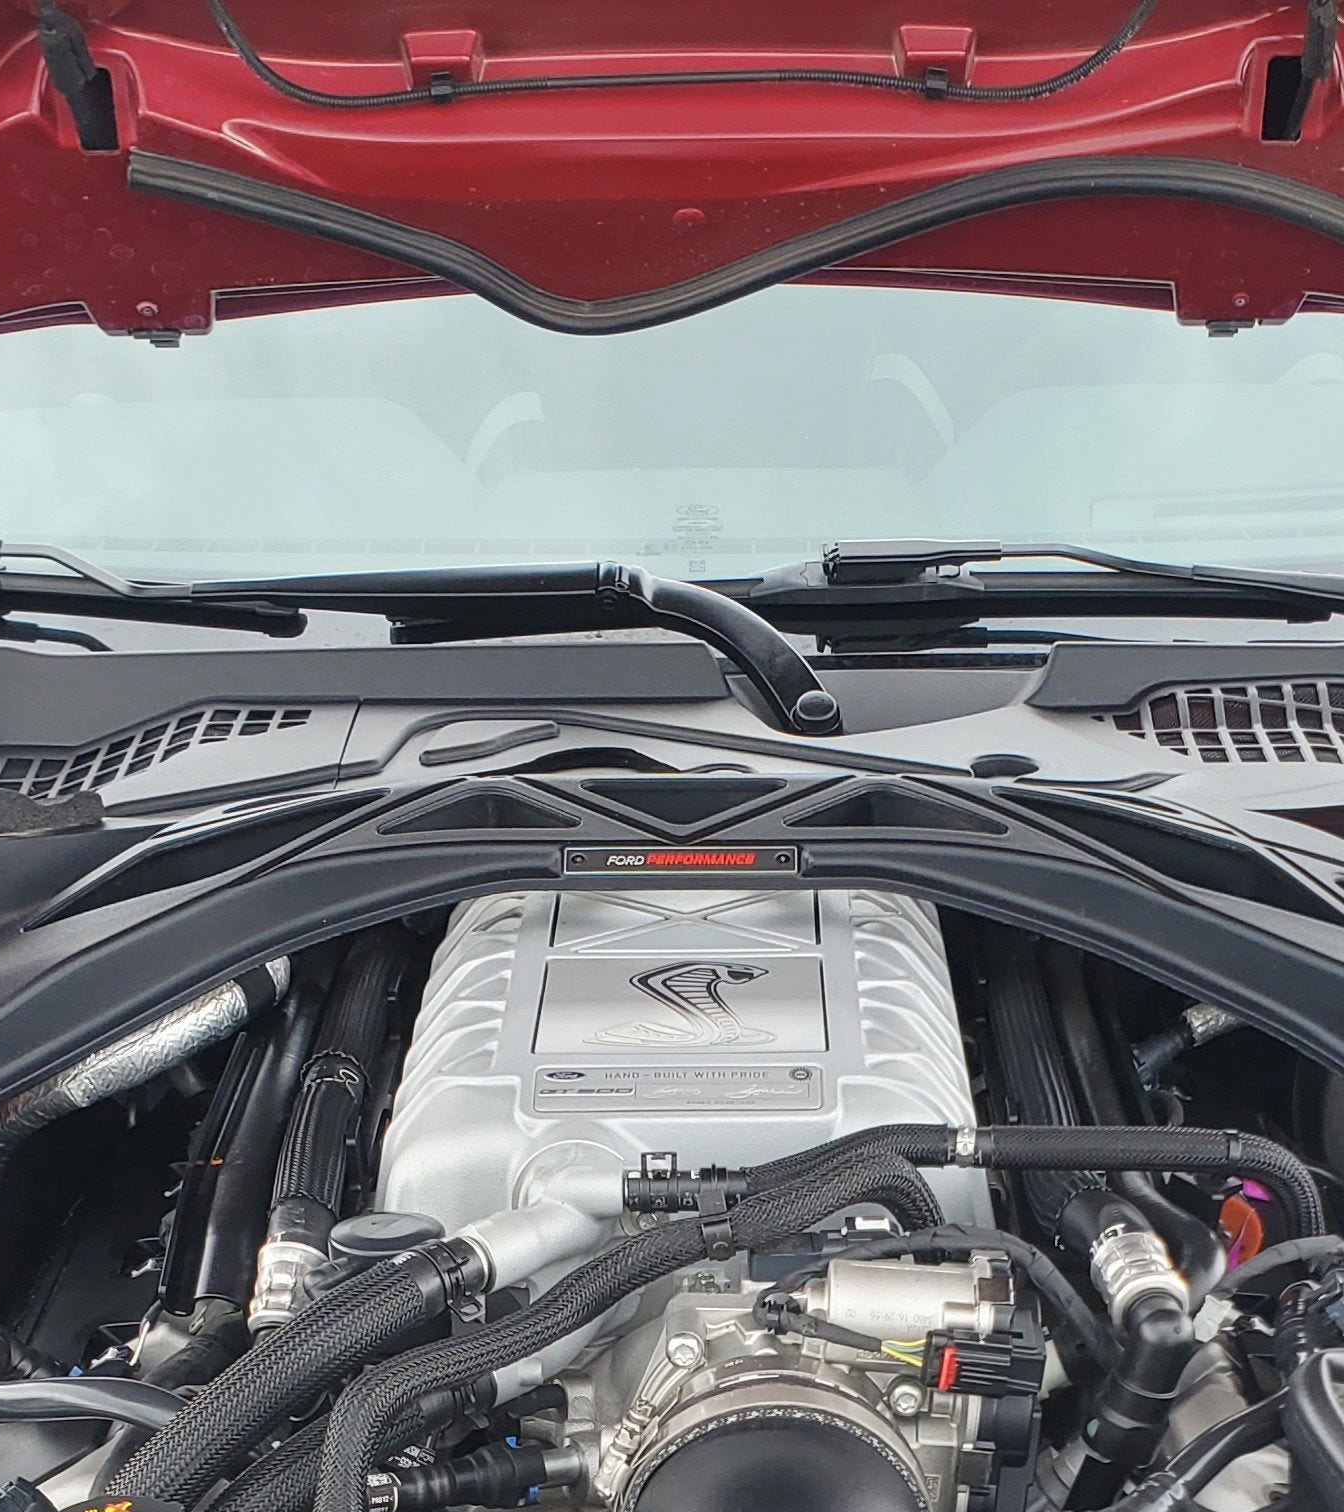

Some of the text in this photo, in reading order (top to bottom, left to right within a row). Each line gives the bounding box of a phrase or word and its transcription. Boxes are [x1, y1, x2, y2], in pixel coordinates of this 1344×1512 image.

[606, 852, 756, 867] FORD PERFORMANCE
[604, 1071, 640, 1079] HAND
[654, 1071, 687, 1079] BUILT
[694, 1071, 725, 1079] WITH
[730, 1071, 768, 1079] PRIDE
